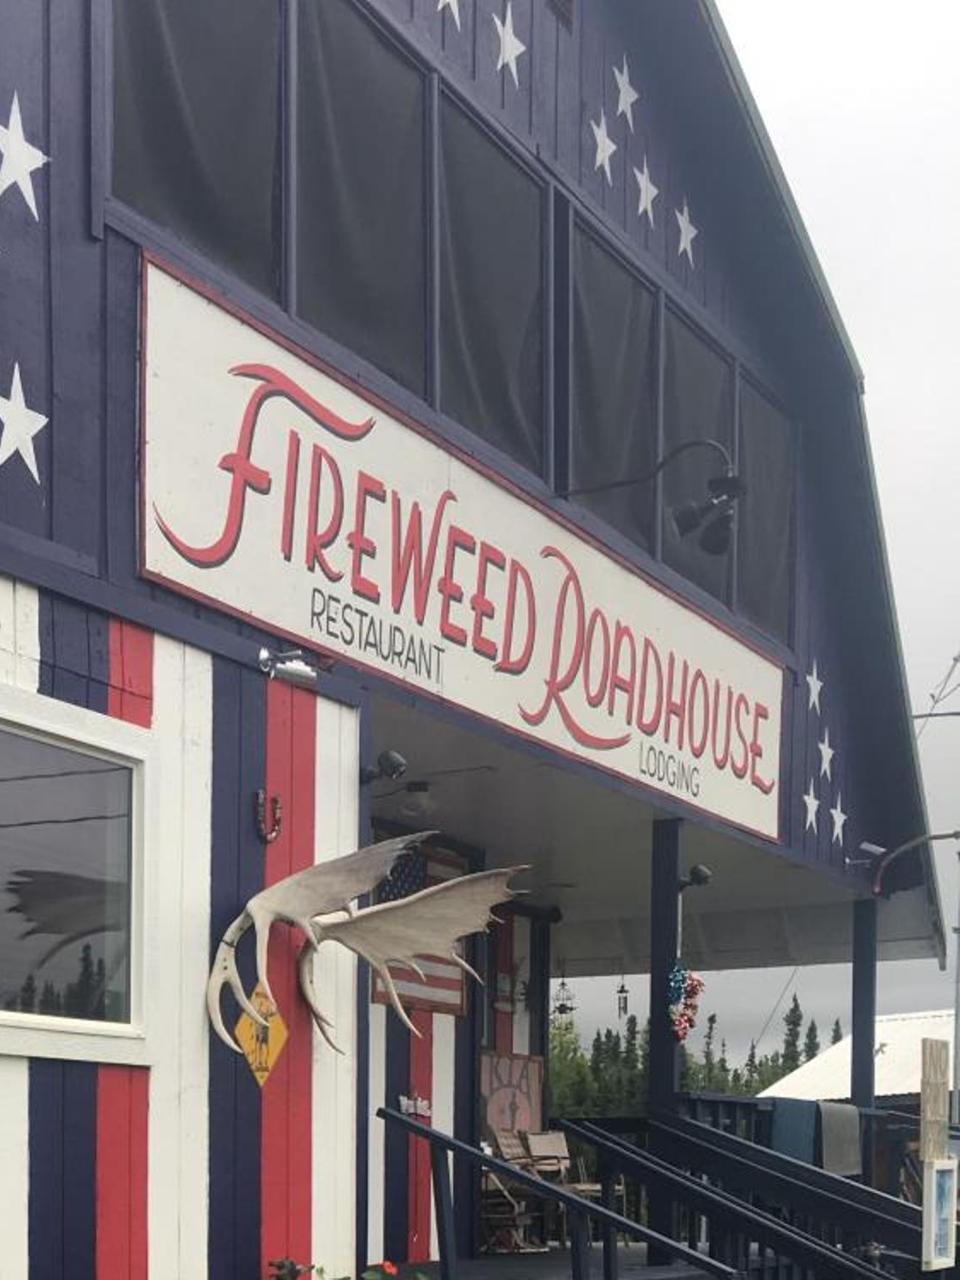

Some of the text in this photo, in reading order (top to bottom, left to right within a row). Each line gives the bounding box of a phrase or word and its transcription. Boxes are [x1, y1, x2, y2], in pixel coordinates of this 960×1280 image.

[152, 362, 775, 795] FIREWEED ROADHOUSE
[310, 588, 445, 684] RESTAURANT
[639, 741, 700, 797] LODGING
